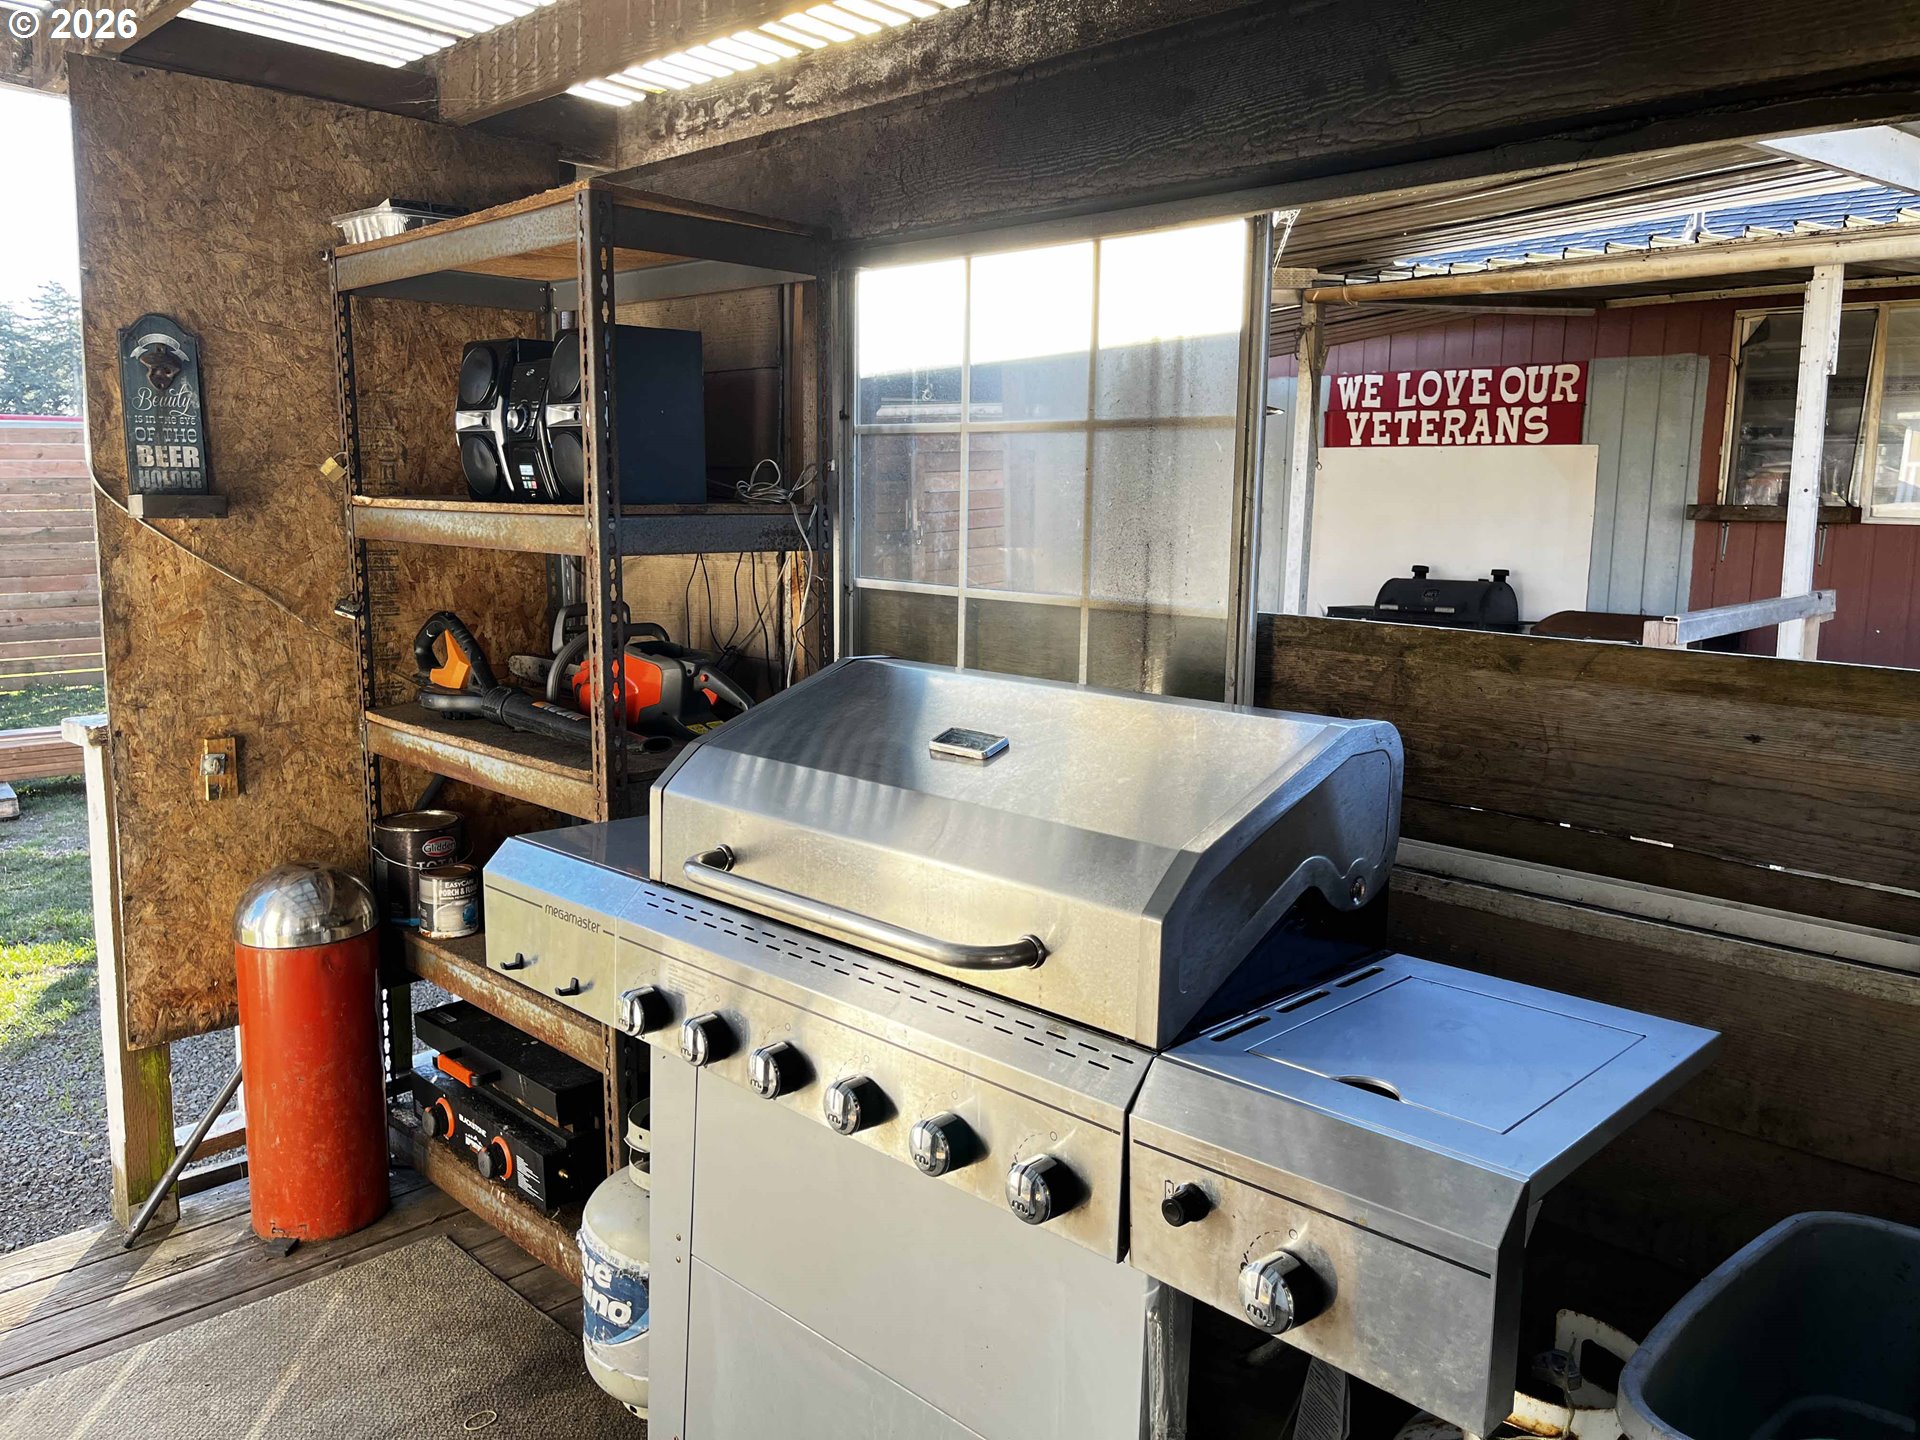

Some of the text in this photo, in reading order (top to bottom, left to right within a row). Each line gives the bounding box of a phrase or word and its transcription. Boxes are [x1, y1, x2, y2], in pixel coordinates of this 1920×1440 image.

[132, 384, 197, 417] Beauty
[1337, 364, 1581, 410] WE LOVE OUR
[134, 426, 156, 442] OF
[1346, 405, 1550, 446] VETERANS
[136, 444, 200, 468] BEER
[138, 469, 203, 489] HOLDER
[423, 841, 456, 852] Glidden
[545, 904, 601, 933] megamaster
[583, 1252, 612, 1289] ue
[583, 1276, 632, 1325] ino
